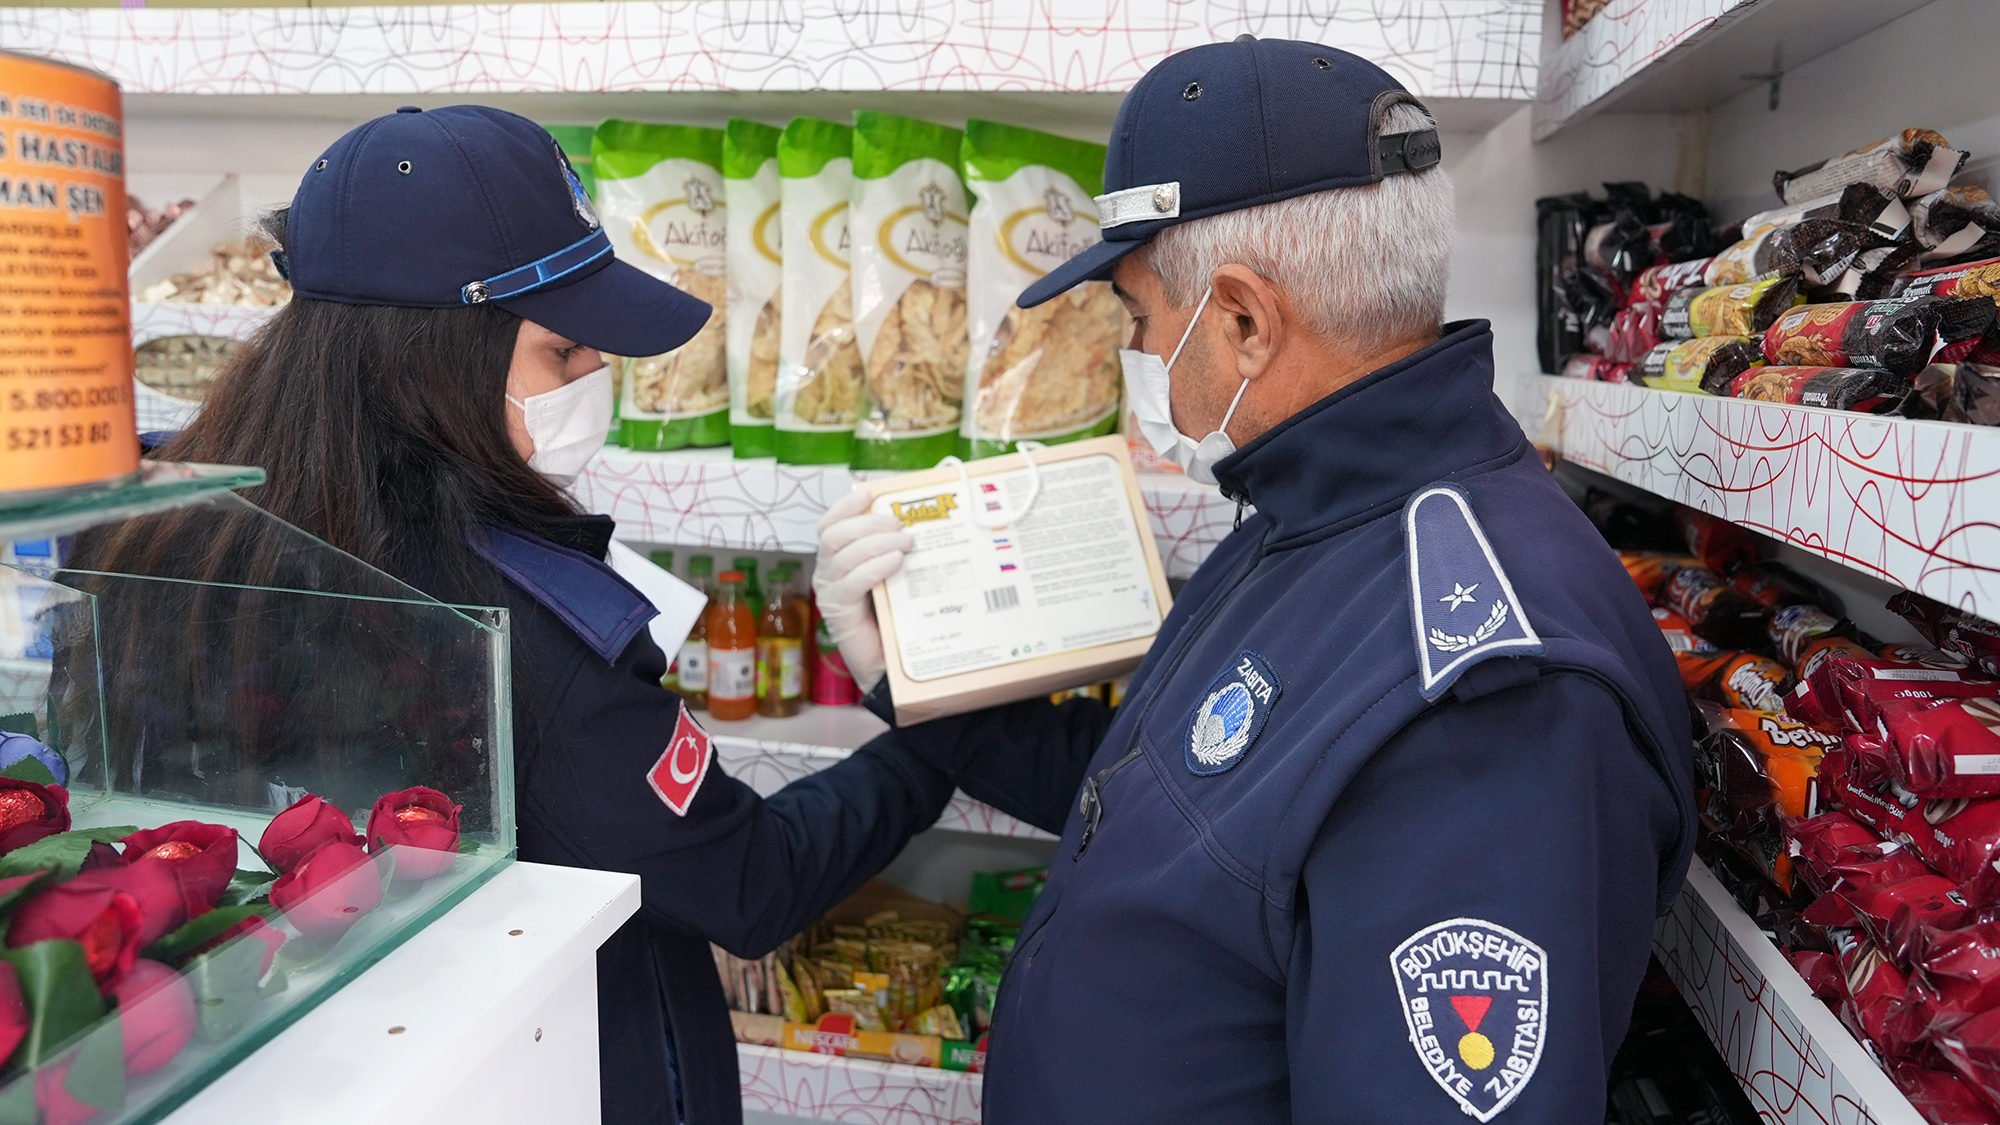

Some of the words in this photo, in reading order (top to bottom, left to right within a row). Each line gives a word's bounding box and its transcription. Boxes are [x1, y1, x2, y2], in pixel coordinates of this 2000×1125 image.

[1237, 658, 1273, 705] ZABITA
[1400, 931, 1540, 980] BÜYÜKŞEHİR
[1410, 996, 1473, 1097] BELEDİYE
[1483, 999, 1540, 1099] ZABITASI
